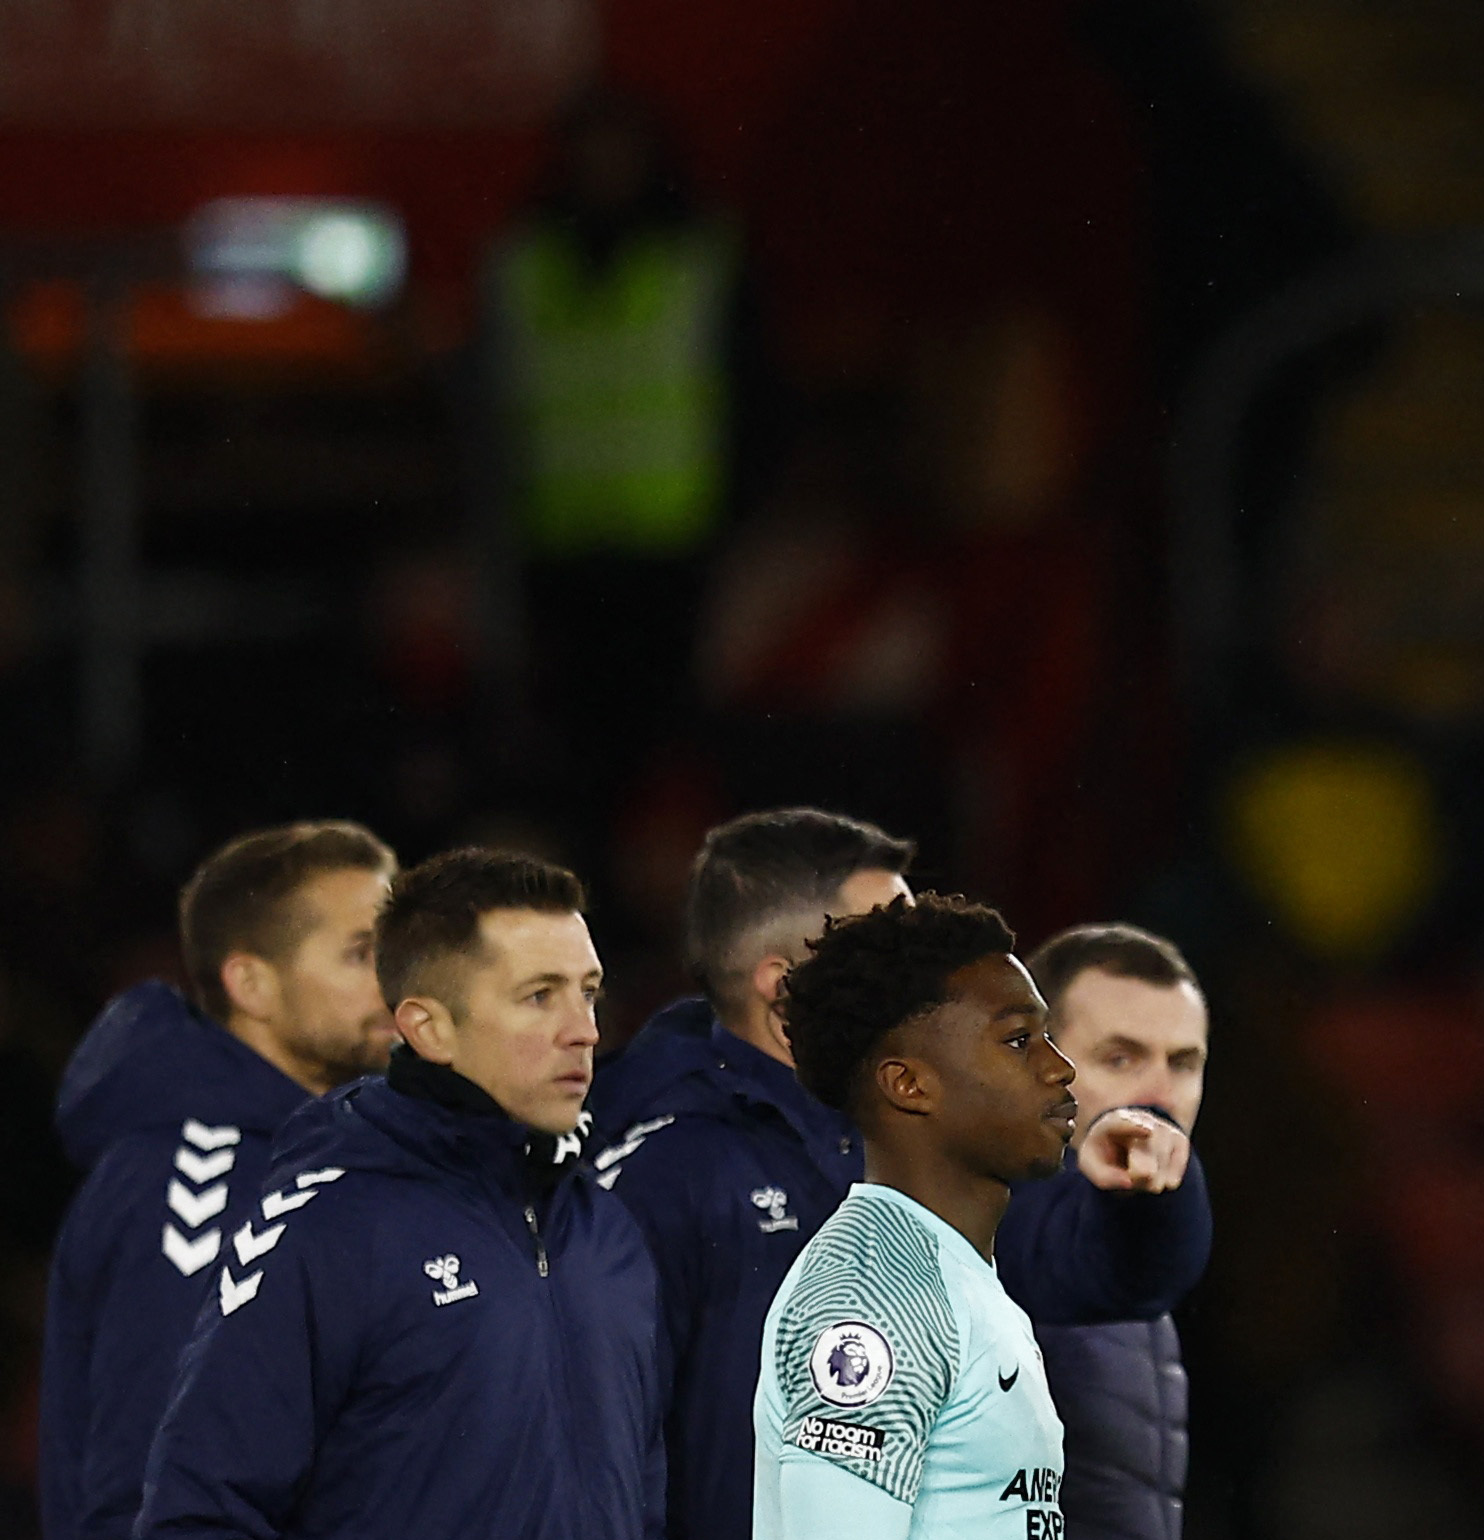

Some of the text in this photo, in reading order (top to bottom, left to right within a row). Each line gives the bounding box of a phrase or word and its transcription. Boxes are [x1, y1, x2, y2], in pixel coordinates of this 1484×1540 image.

[799, 1417, 876, 1446] No room
[821, 1437, 881, 1462] racism
